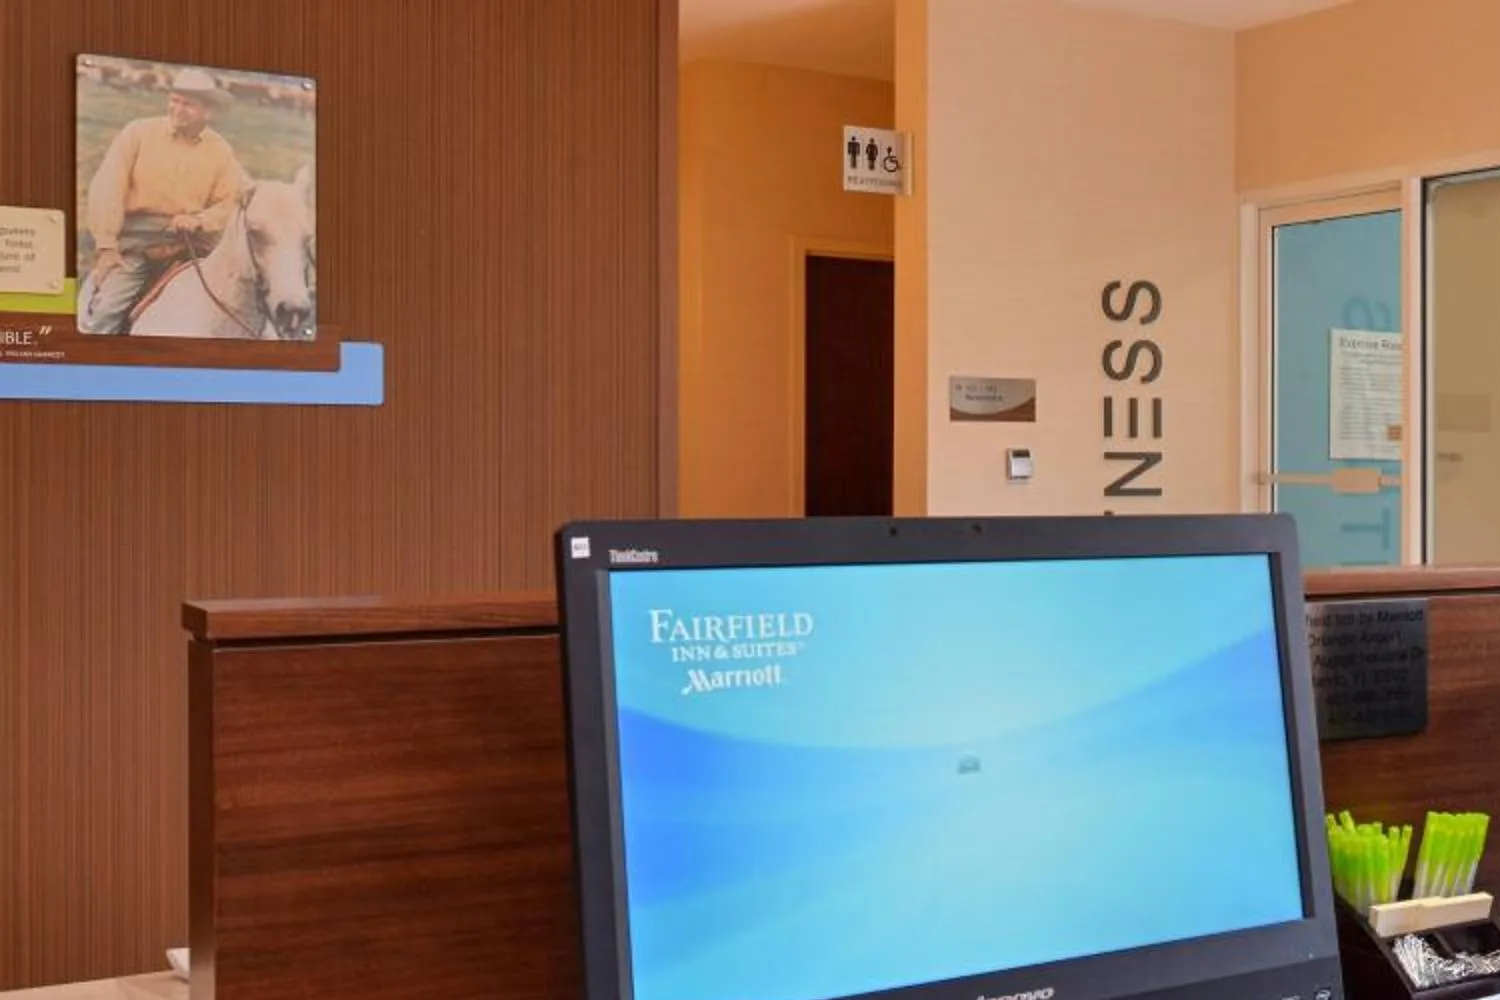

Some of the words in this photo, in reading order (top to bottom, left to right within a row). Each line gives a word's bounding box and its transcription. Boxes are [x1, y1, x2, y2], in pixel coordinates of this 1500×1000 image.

[1101, 279, 1163, 516] NESS
[671, 645, 711, 663] INN
[713, 645, 730, 660] &
[732, 641, 799, 660] SUITES
[681, 665, 782, 695] Marriott
